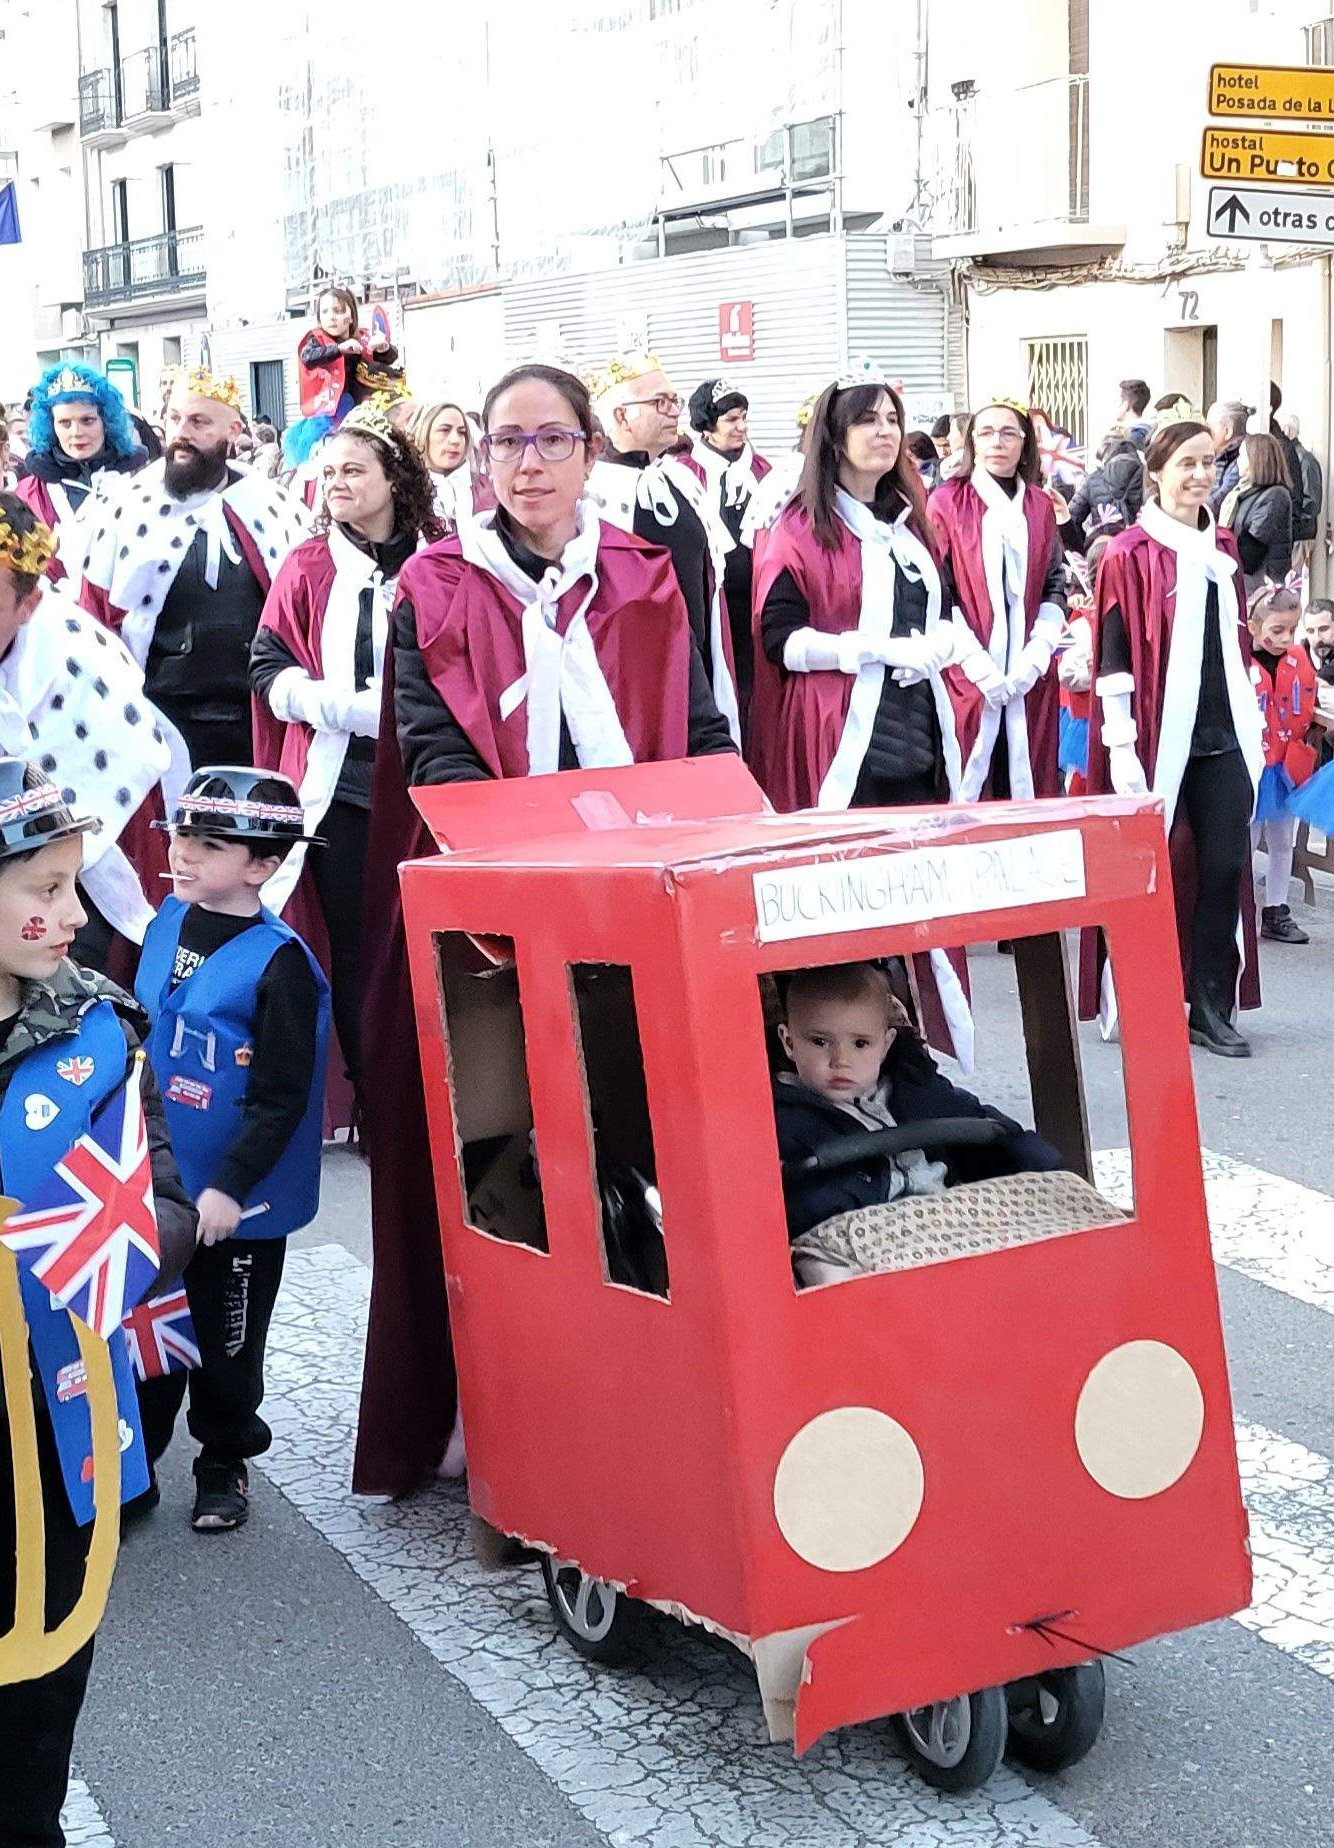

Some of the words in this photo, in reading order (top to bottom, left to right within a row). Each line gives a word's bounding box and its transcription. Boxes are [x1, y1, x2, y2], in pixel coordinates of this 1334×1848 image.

[1217, 73, 1259, 90] hotel
[1217, 93, 1276, 111] Posada
[1282, 96, 1303, 112] de
[1307, 97, 1322, 113] la
[1210, 134, 1264, 151] hostal
[1209, 153, 1241, 173] Un
[1250, 155, 1320, 177] Puto
[1259, 207, 1318, 229] otras
[1178, 291, 1199, 320] 72
[760, 860, 951, 926] BUCKINGHAM
